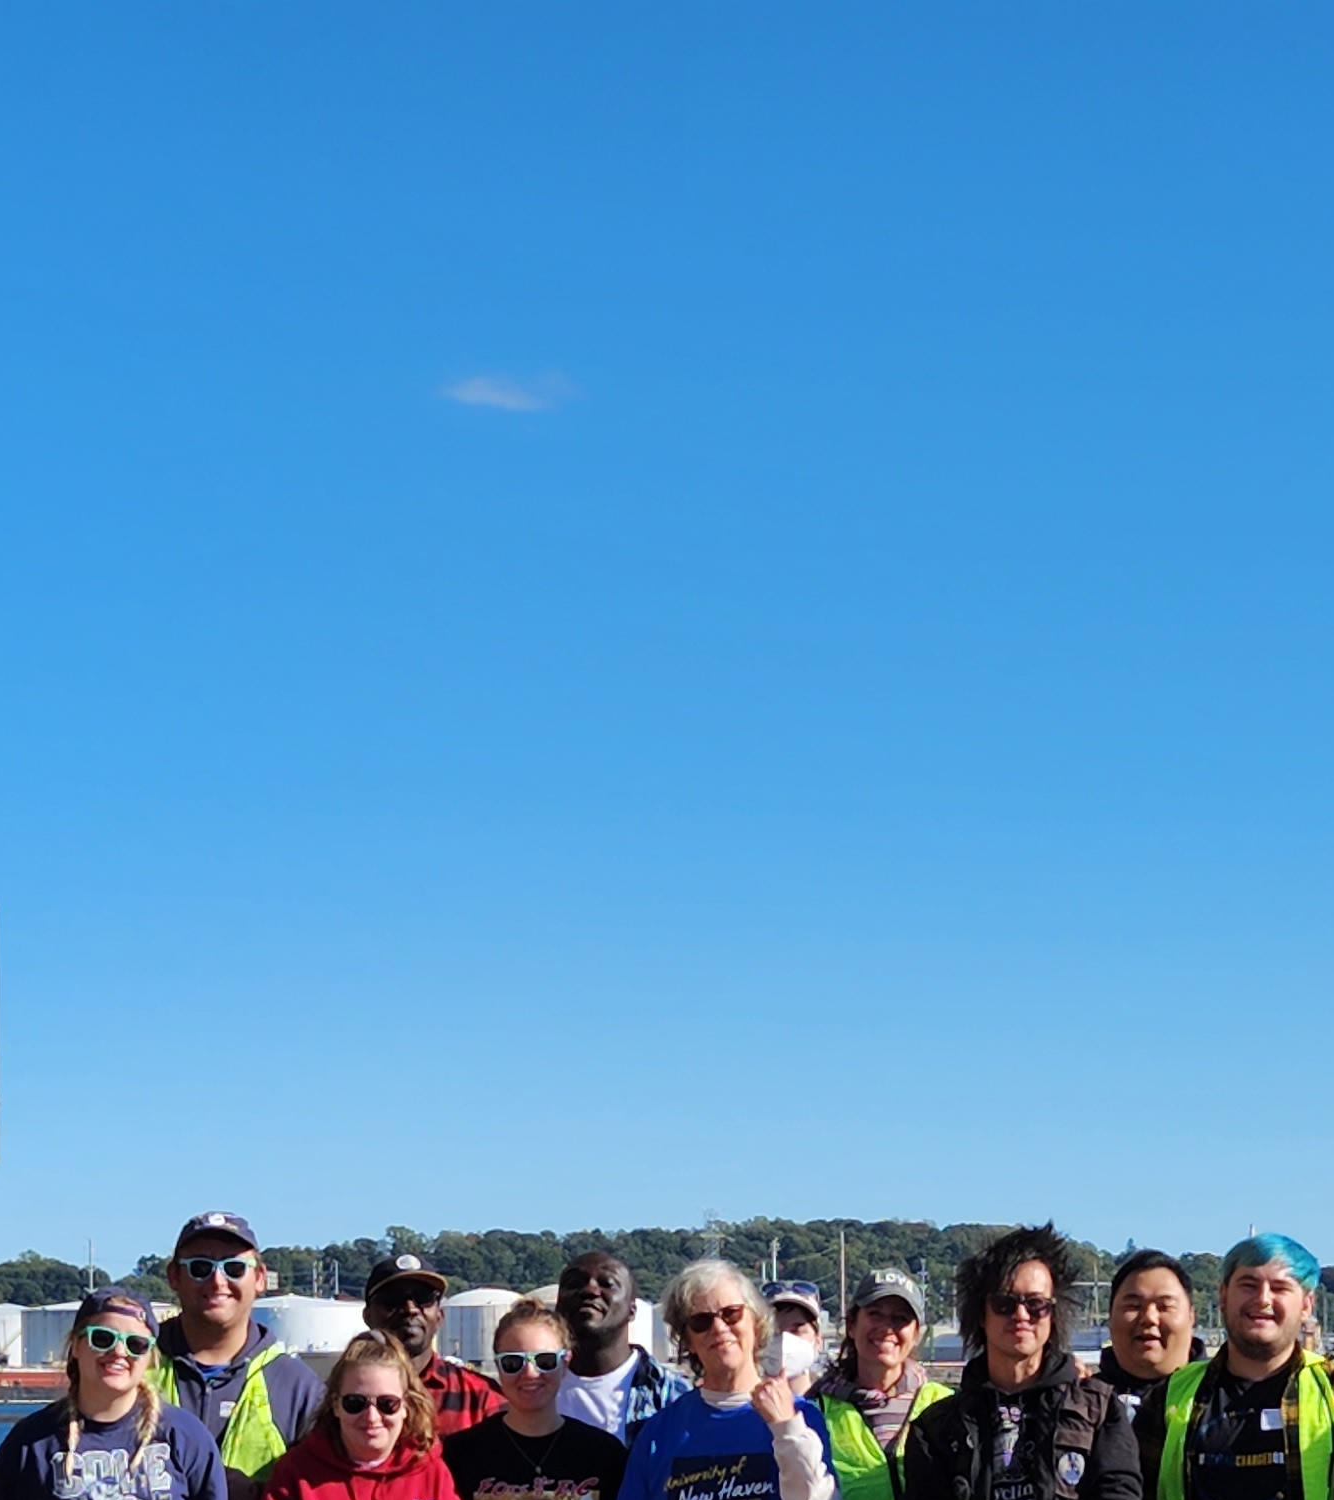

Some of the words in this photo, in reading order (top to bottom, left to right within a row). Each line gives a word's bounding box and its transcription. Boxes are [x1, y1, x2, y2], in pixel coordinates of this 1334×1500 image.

[663, 1465, 726, 1492] University
[730, 1455, 747, 1475] of
[718, 1475, 775, 1500] Haven
